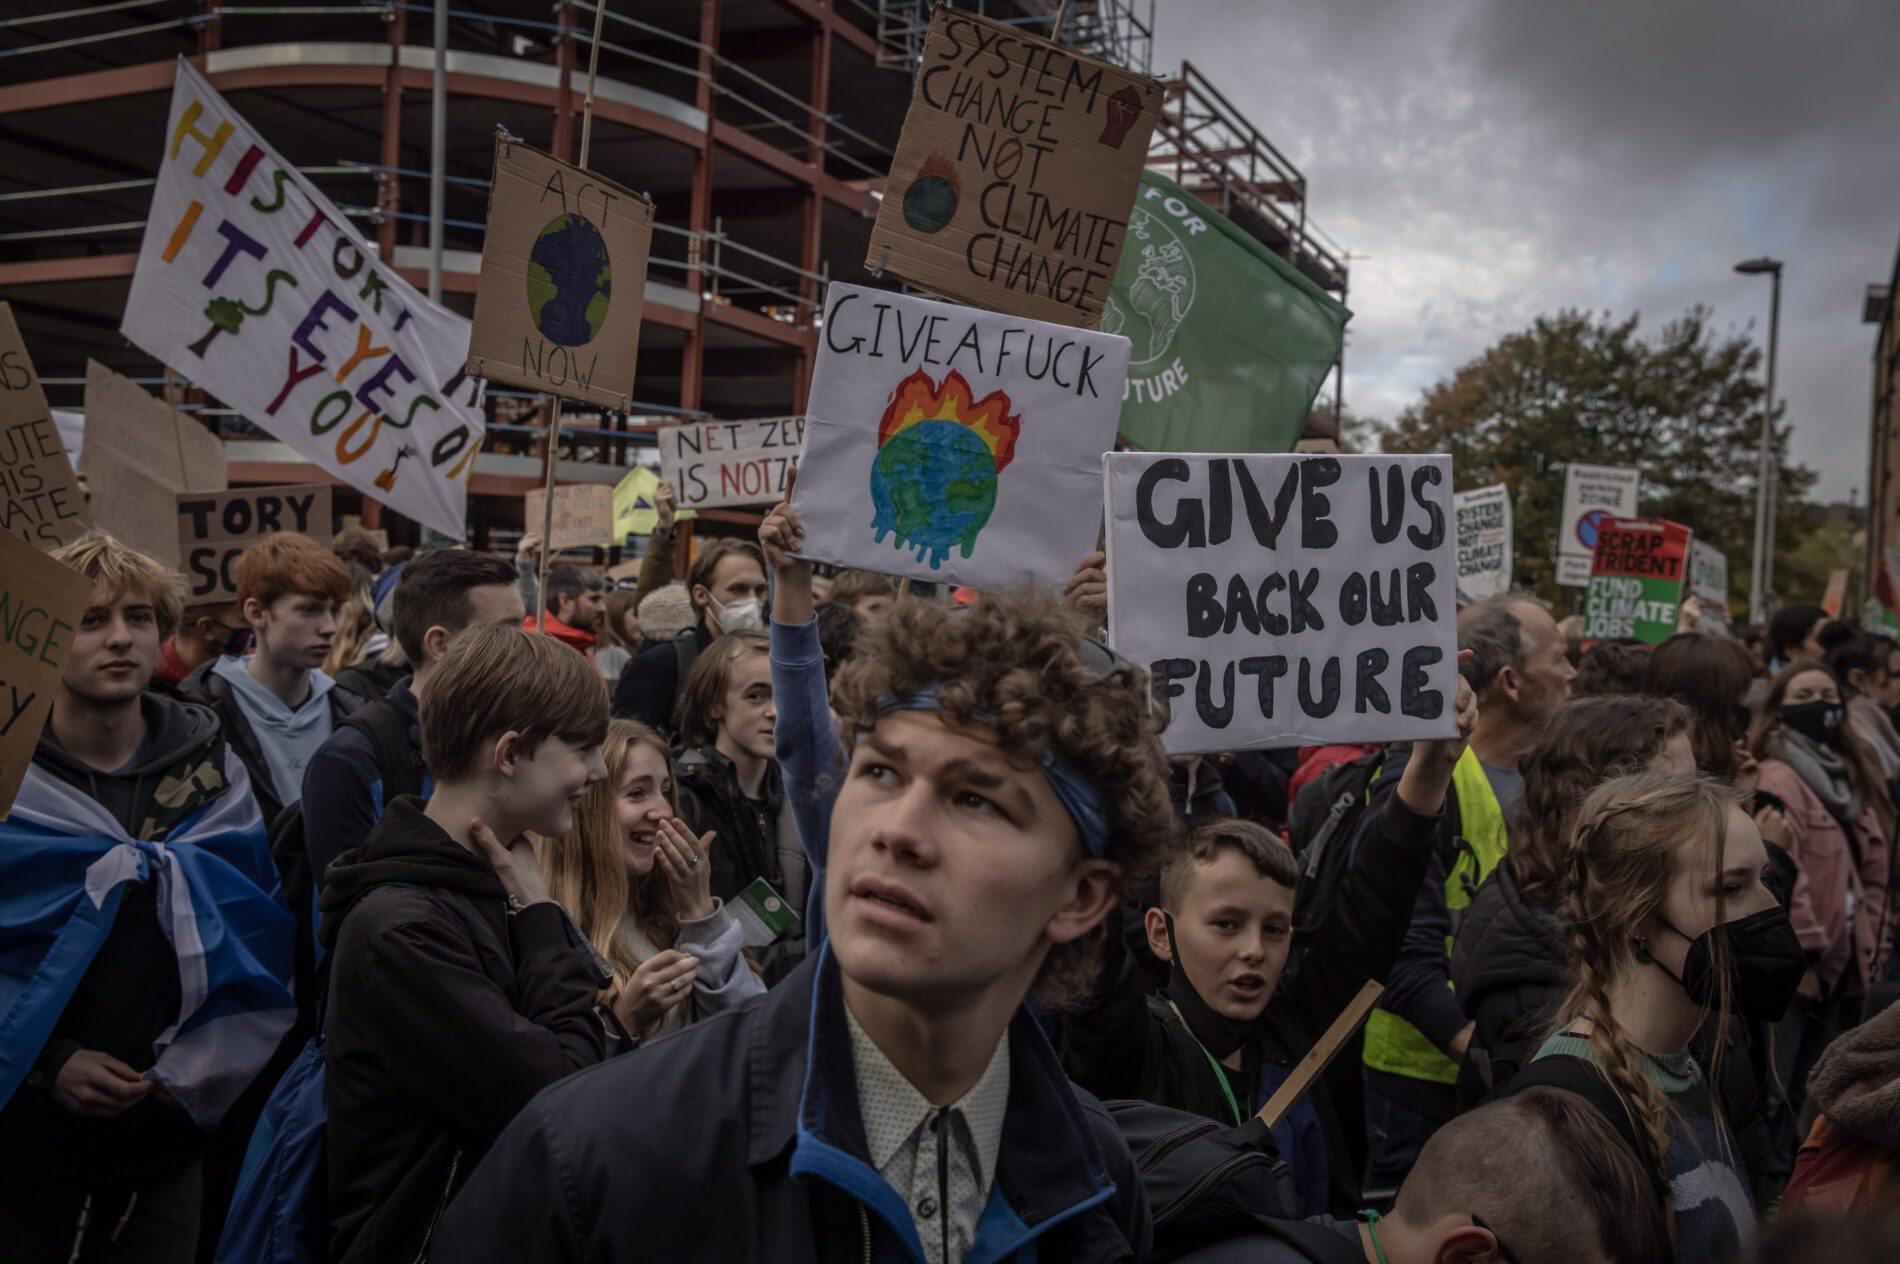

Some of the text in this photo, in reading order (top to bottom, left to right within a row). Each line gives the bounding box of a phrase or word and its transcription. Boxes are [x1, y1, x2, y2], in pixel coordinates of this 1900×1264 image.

[939, 20, 1104, 114] SYSTEM
[922, 65, 1064, 145] CHANGE
[957, 123, 1055, 190] NOT
[540, 169, 619, 229] ACT
[980, 181, 1128, 267] CLIMATE
[1144, 186, 1208, 237] FOR
[966, 233, 1107, 312] CHANGE
[161, 199, 298, 317] ITS
[291, 289, 442, 429] EYES
[523, 336, 598, 392] NOW
[826, 294, 1105, 399] GIVE A FUCK
[265, 345, 383, 465] YOU
[677, 424, 742, 459] NET
[678, 463, 709, 502] IS
[721, 458, 772, 498] NOT
[1136, 457, 1446, 551] GIVE US
[178, 495, 316, 540] TORY
[1456, 502, 1504, 522] SYSTEM
[1457, 517, 1504, 535] CHANGE
[1458, 534, 1479, 548] NOT
[1458, 543, 1504, 563] CLIMATE
[1594, 551, 1681, 576] TRIDENT
[1598, 532, 1664, 552] SCRAP
[1458, 559, 1504, 577] CHANGE
[1590, 577, 1643, 598] FUND
[1186, 561, 1439, 638] BACK OUR
[1587, 598, 1675, 624] CLIMATE
[1584, 617, 1635, 638] JOBS
[1150, 645, 1445, 729] FUTURE
